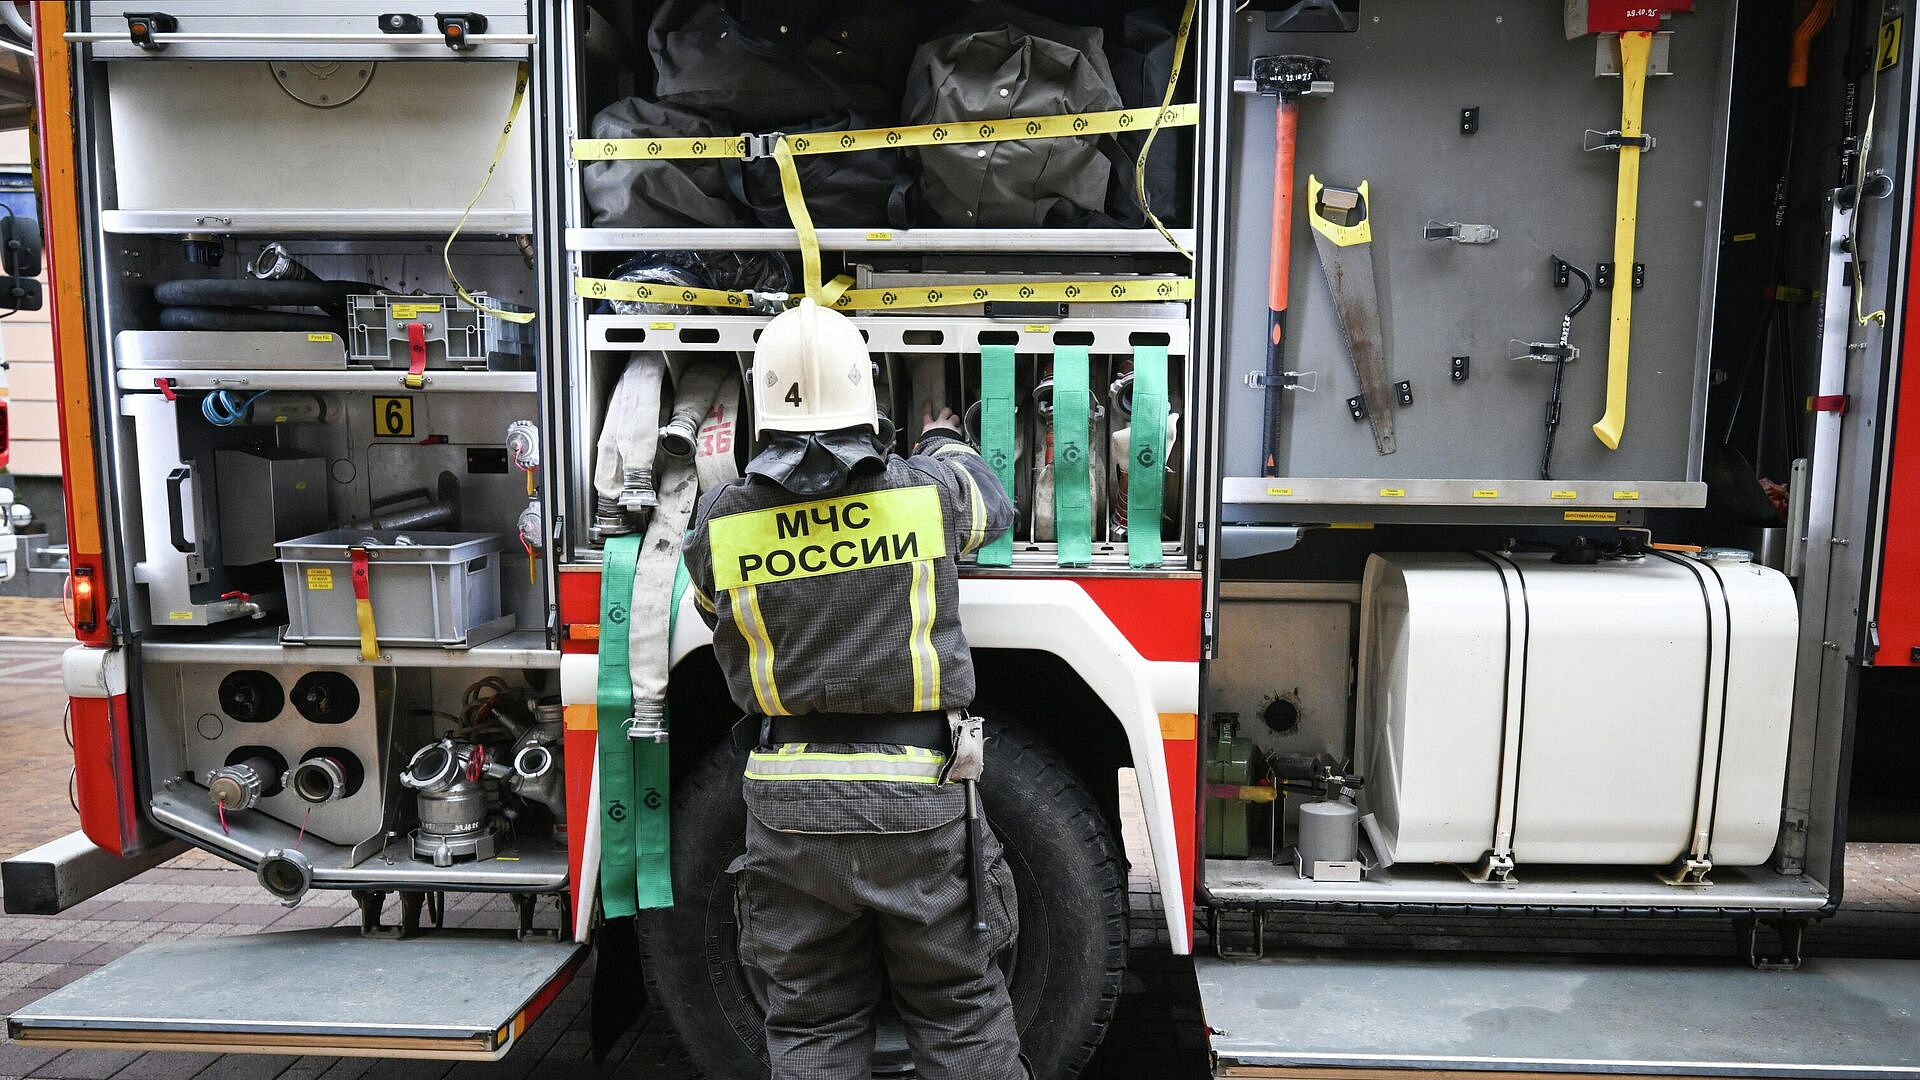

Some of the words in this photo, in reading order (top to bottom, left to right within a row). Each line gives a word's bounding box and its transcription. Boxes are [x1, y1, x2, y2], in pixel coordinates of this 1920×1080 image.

[1881, 23, 1896, 67] 2
[784, 382, 802, 408] 4
[385, 399, 404, 434] 6
[699, 430, 733, 458] 36
[775, 502, 871, 539] МЧС
[738, 531, 919, 581] РОССИИ
